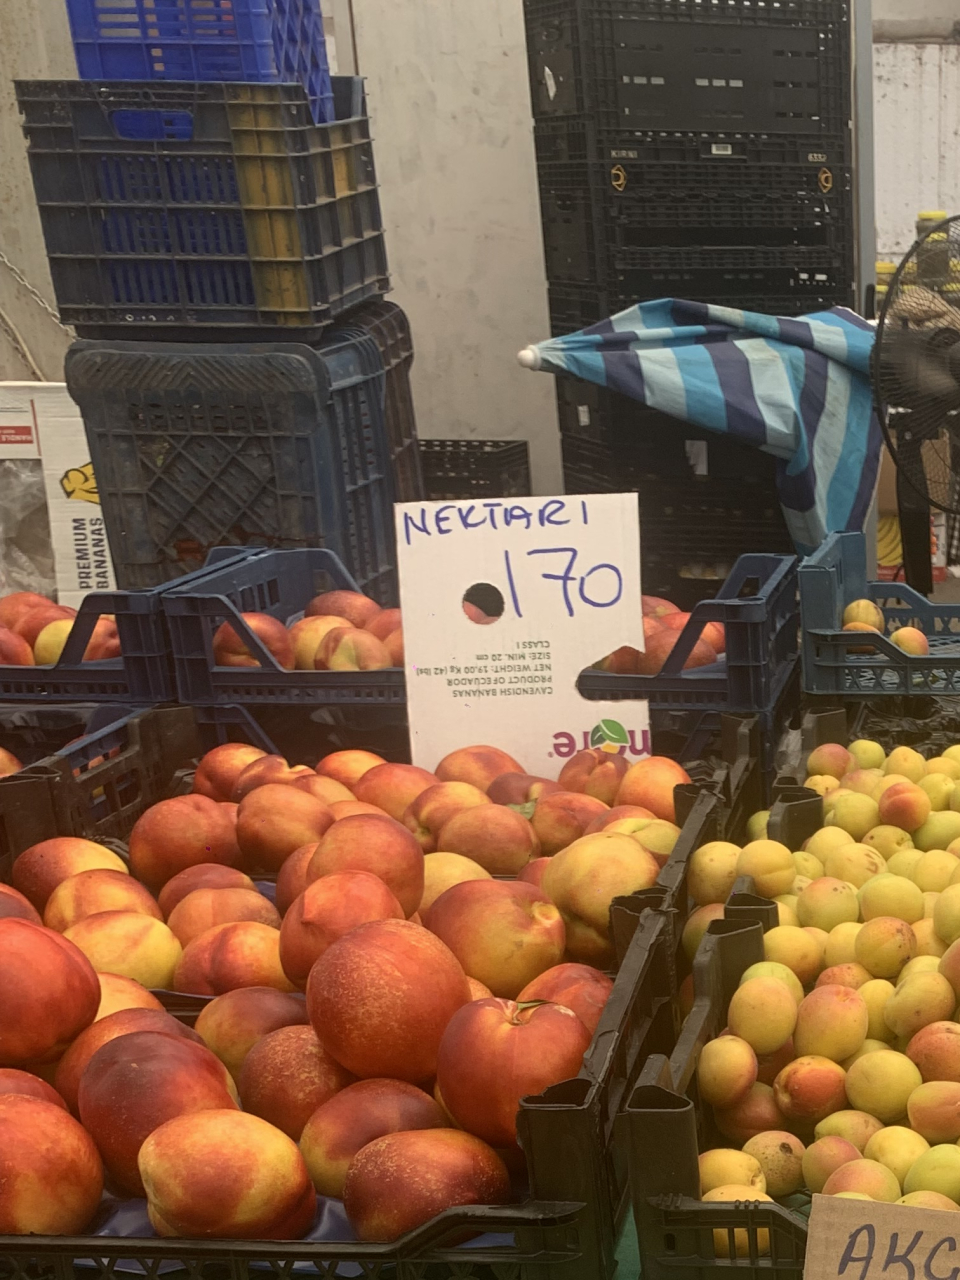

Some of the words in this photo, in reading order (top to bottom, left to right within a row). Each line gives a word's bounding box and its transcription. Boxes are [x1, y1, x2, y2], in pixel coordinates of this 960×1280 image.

[72, 518, 93, 589] PREMIUM
[90, 517, 110, 589] BANANAS
[505, 547, 623, 618] 170
[522, 641, 551, 649] CLASS
[491, 653, 502, 661] 20
[505, 652, 526, 661] MIN.
[528, 652, 551, 660] SIZE:
[433, 666, 448, 675] (42
[449, 665, 462, 674] Kg
[464, 665, 488, 674] 19.00
[491, 664, 531, 673] WEIGHT:
[533, 663, 552, 671] NET
[446, 677, 492, 686] ECUADOR
[508, 675, 553, 684] PRODUCT
[452, 688, 497, 698] BANANAS
[500, 686, 553, 696] CAVENDISH
